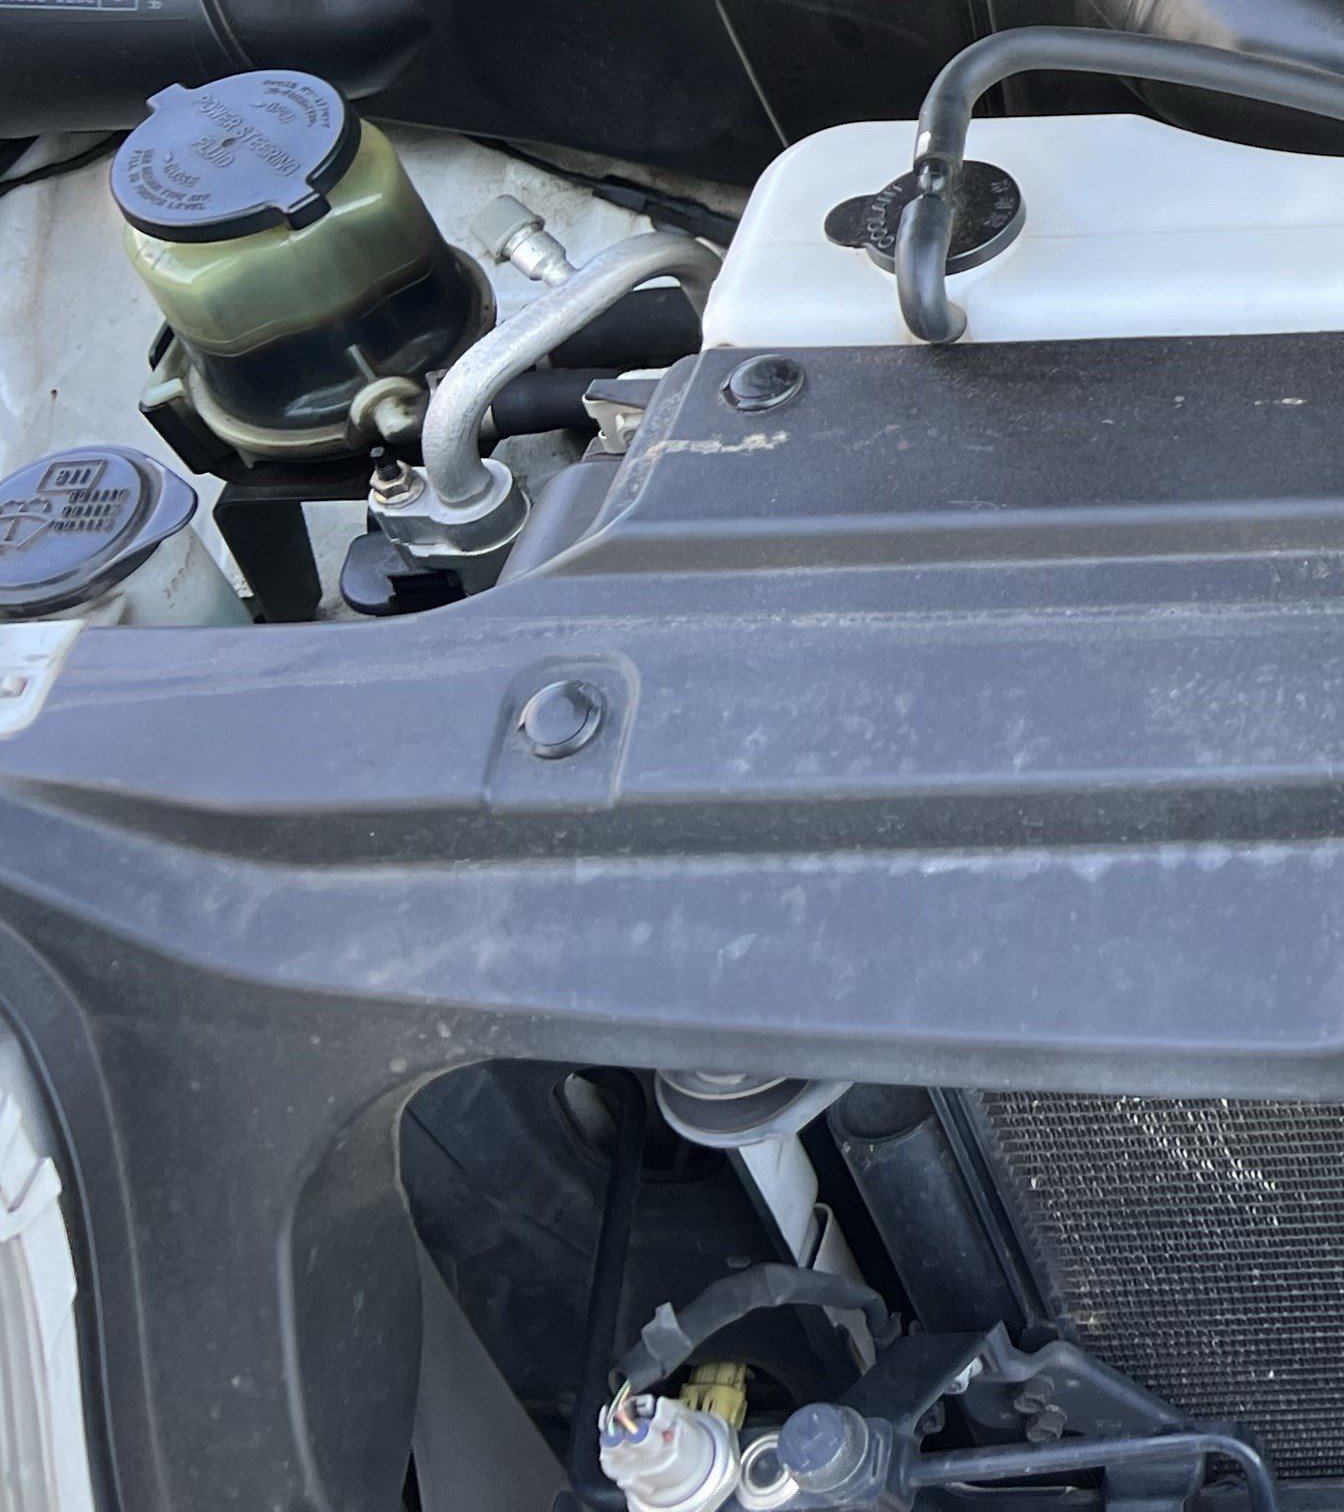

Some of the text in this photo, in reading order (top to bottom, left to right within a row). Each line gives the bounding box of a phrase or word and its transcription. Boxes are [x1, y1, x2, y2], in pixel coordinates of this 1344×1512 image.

[196, 94, 243, 132] POWER
[191, 136, 236, 169] FLUID
[235, 125, 301, 177] STEERING
